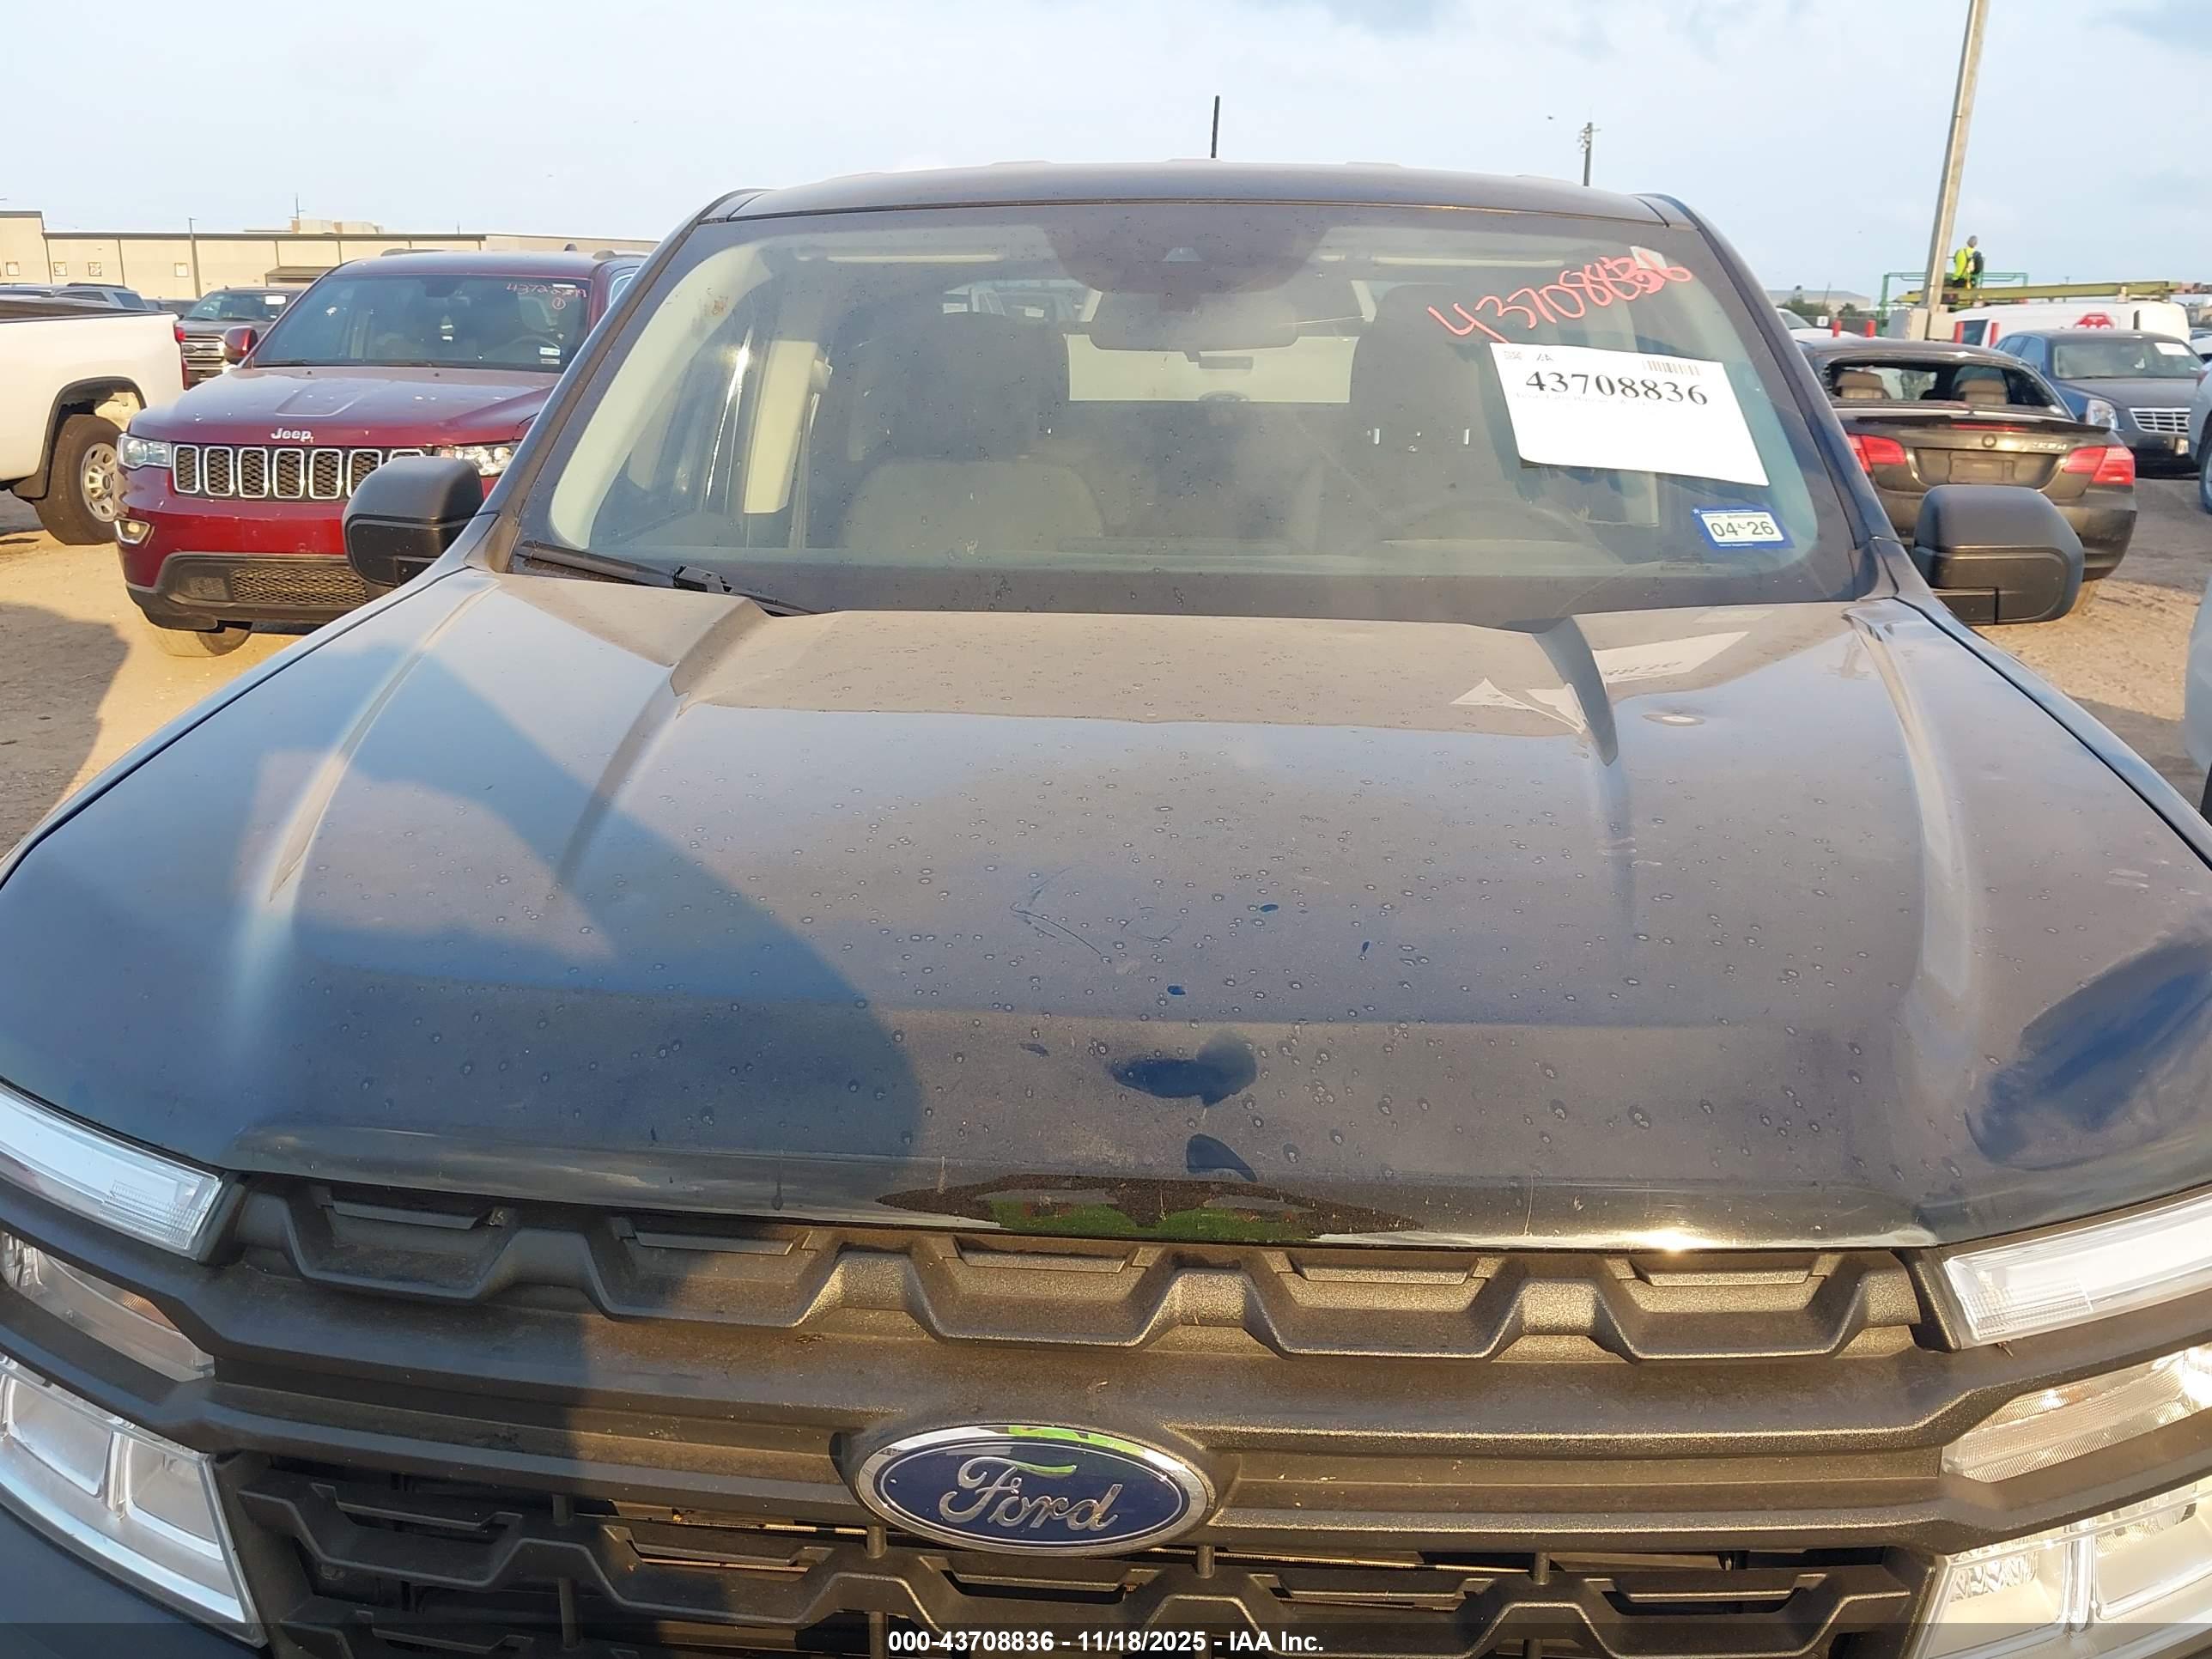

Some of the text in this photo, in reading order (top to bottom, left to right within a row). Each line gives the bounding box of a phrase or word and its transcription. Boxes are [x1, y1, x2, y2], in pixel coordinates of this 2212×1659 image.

[1525, 371, 1708, 405] 43708836
[270, 428, 312, 442] Jeep
[939, 1456, 1124, 1532] Ford
